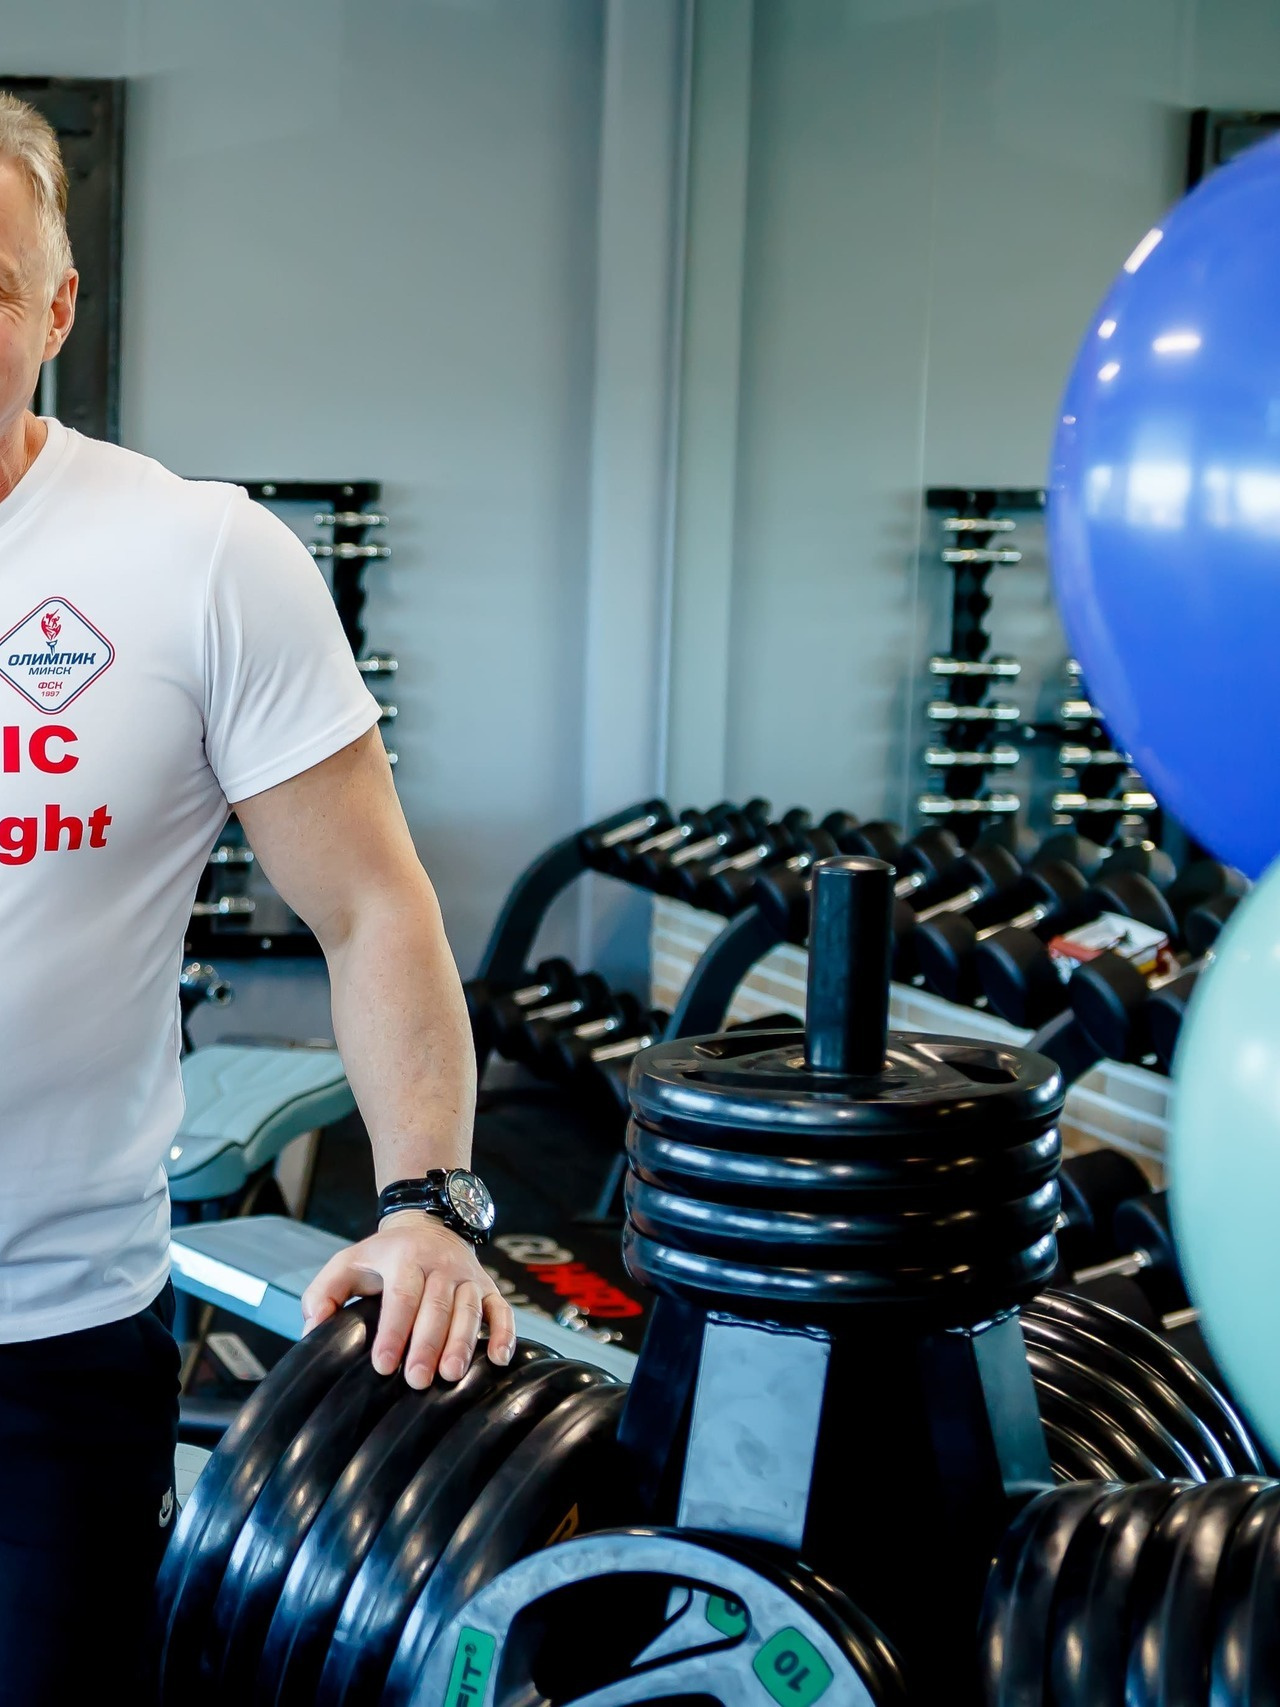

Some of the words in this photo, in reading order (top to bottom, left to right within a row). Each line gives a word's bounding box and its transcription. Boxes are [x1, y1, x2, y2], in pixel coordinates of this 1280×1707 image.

[8, 652, 96, 666] ОЛИМПИК
[28, 666, 72, 675] МИНСК
[774, 1650, 810, 1692] 10
